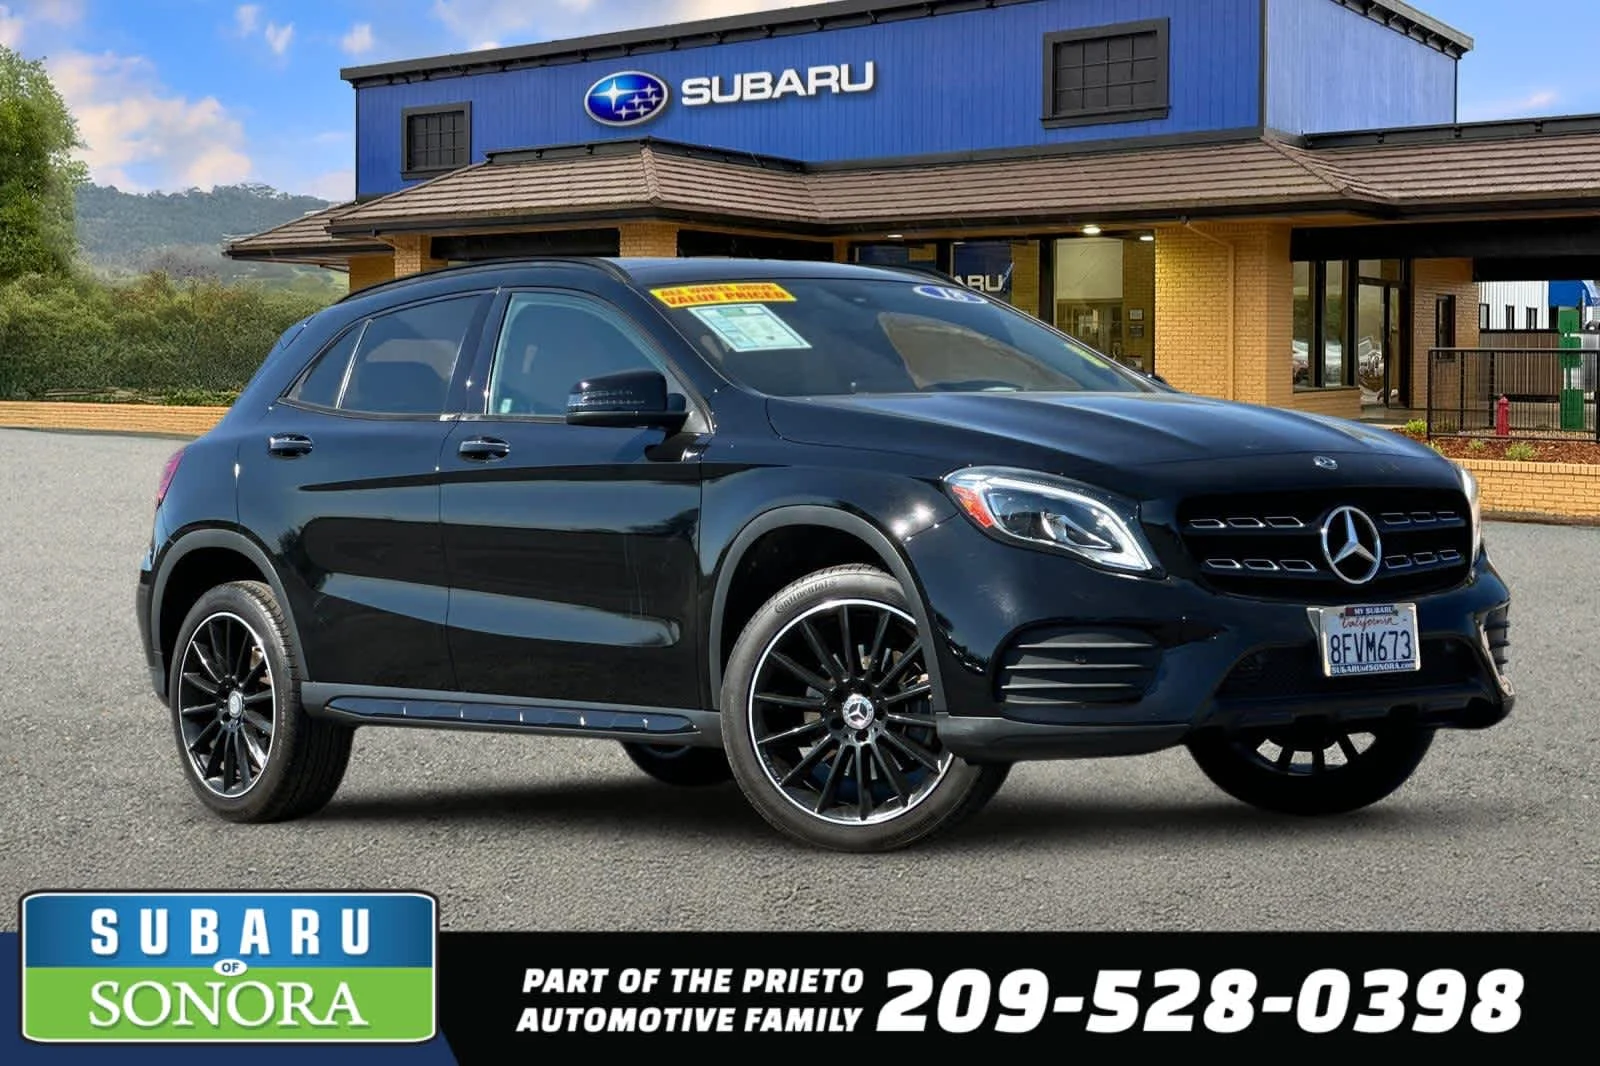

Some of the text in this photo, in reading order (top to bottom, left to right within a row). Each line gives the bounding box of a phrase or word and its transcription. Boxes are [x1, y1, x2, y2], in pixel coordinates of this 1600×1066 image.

[681, 60, 874, 106] SUBARU
[1342, 616, 1399, 632] California
[1330, 630, 1412, 664] 8FVM673
